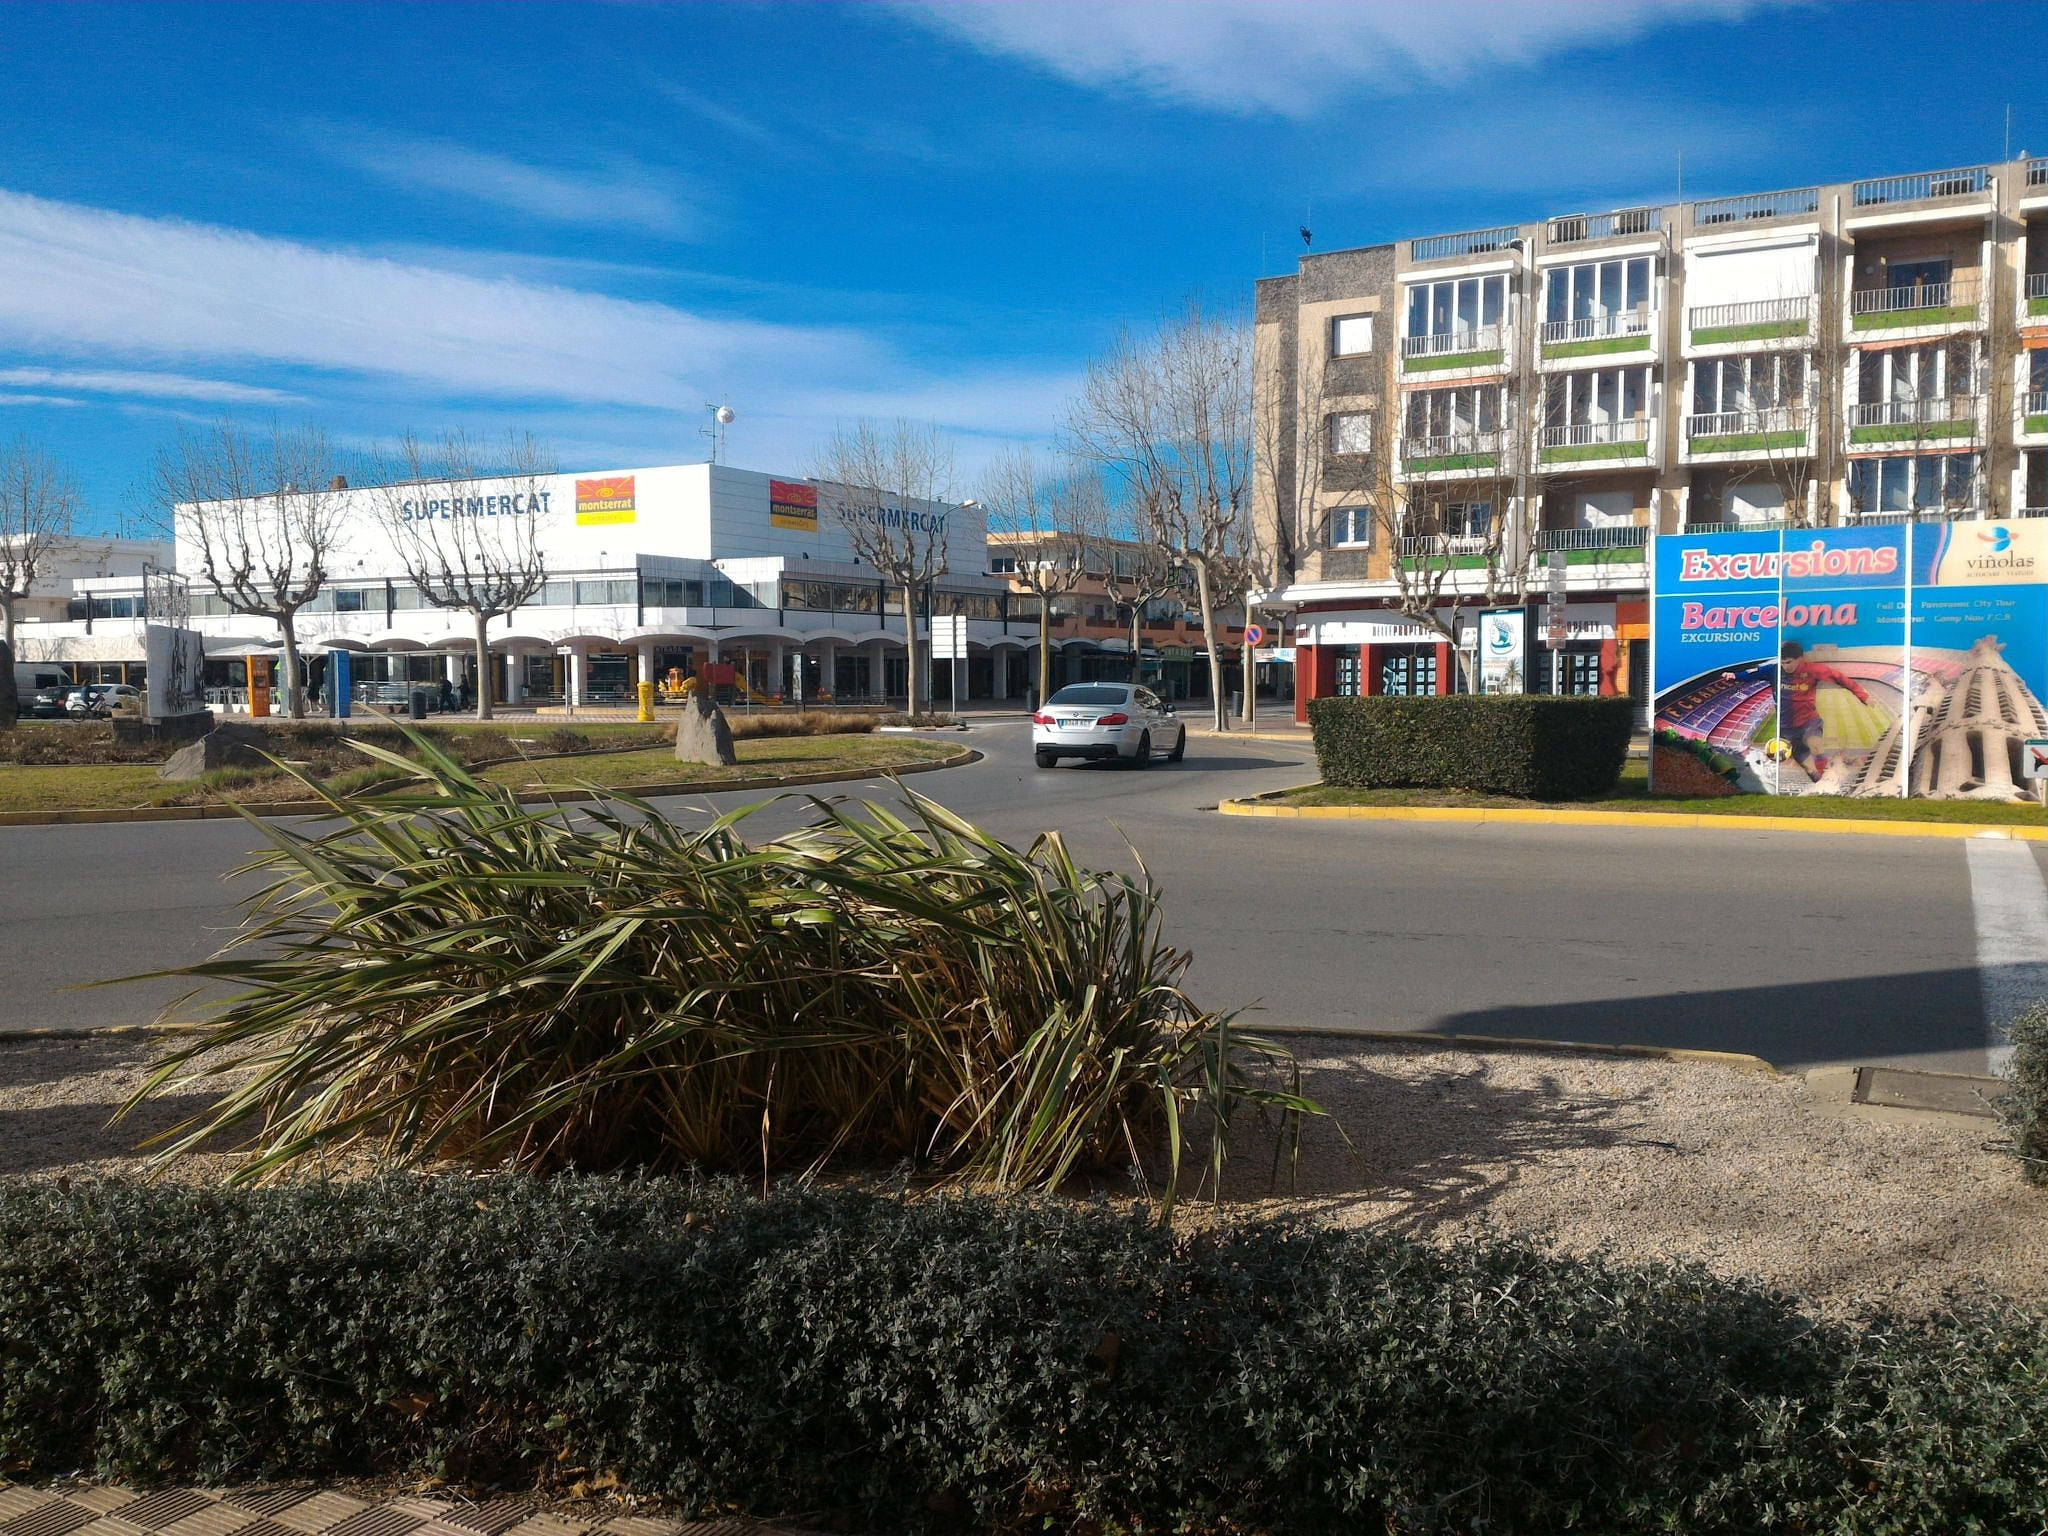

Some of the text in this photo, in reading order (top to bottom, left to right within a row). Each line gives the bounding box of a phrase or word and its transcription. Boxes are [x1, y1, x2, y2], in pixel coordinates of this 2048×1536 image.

[402, 492, 551, 521] SUPERMERCAT
[578, 499, 632, 511] montserrat
[772, 504, 815, 517] montserrat
[1680, 540, 1897, 581] Excursions
[1681, 597, 1857, 630] Barcelona
[1681, 631, 1760, 643] EXCURSIONS
